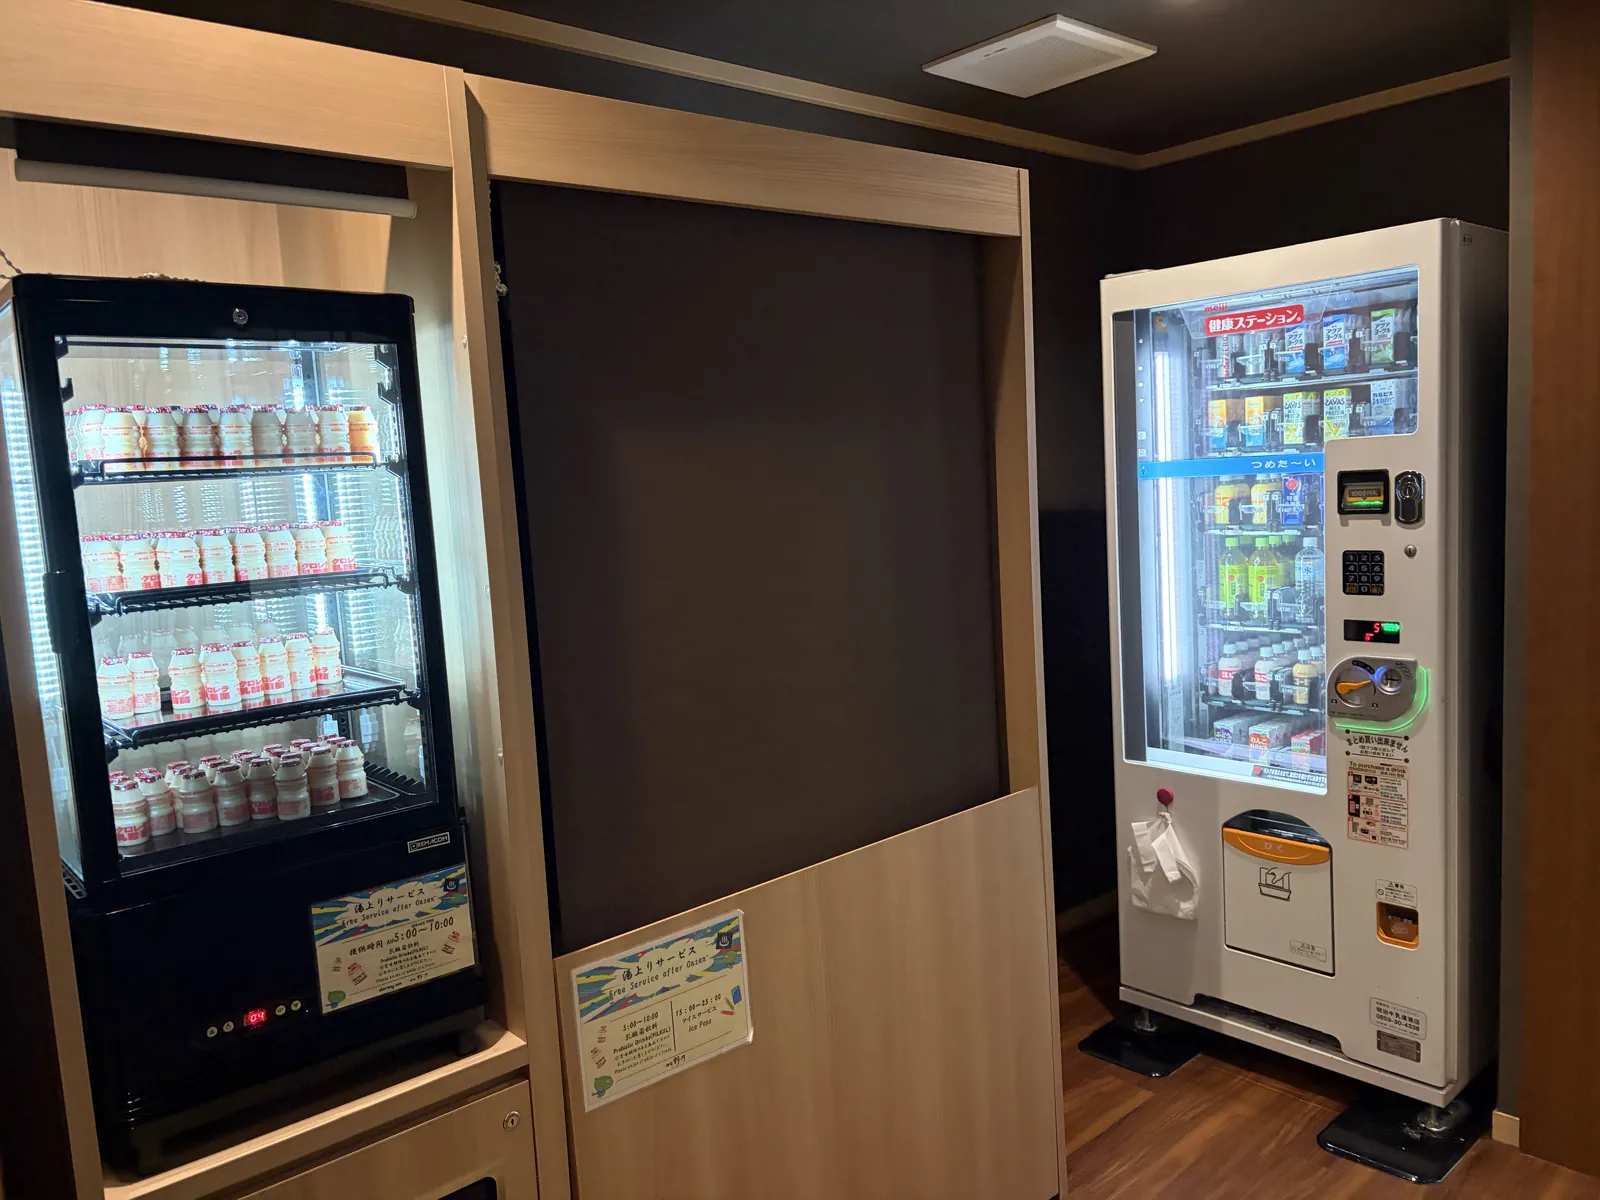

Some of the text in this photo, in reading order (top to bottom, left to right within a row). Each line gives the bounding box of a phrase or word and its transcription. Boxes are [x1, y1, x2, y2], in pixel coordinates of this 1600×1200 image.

[1204, 302, 1228, 313] meiji
[1208, 310, 1299, 333] 健康ステーション
[1346, 735, 1408, 753] まとめ買い出来ません
[1358, 762, 1385, 771] purchase
[416, 835, 448, 848] REMACOM
[354, 888, 425, 914] 湯上りサービス
[341, 897, 435, 928] Free Service after Onsen
[622, 946, 697, 981] 湯上りサービス
[608, 957, 707, 1001] Free Service after Onsen
[682, 1006, 718, 1023] アイスサービス
[688, 1018, 712, 1033] Ice Pops
